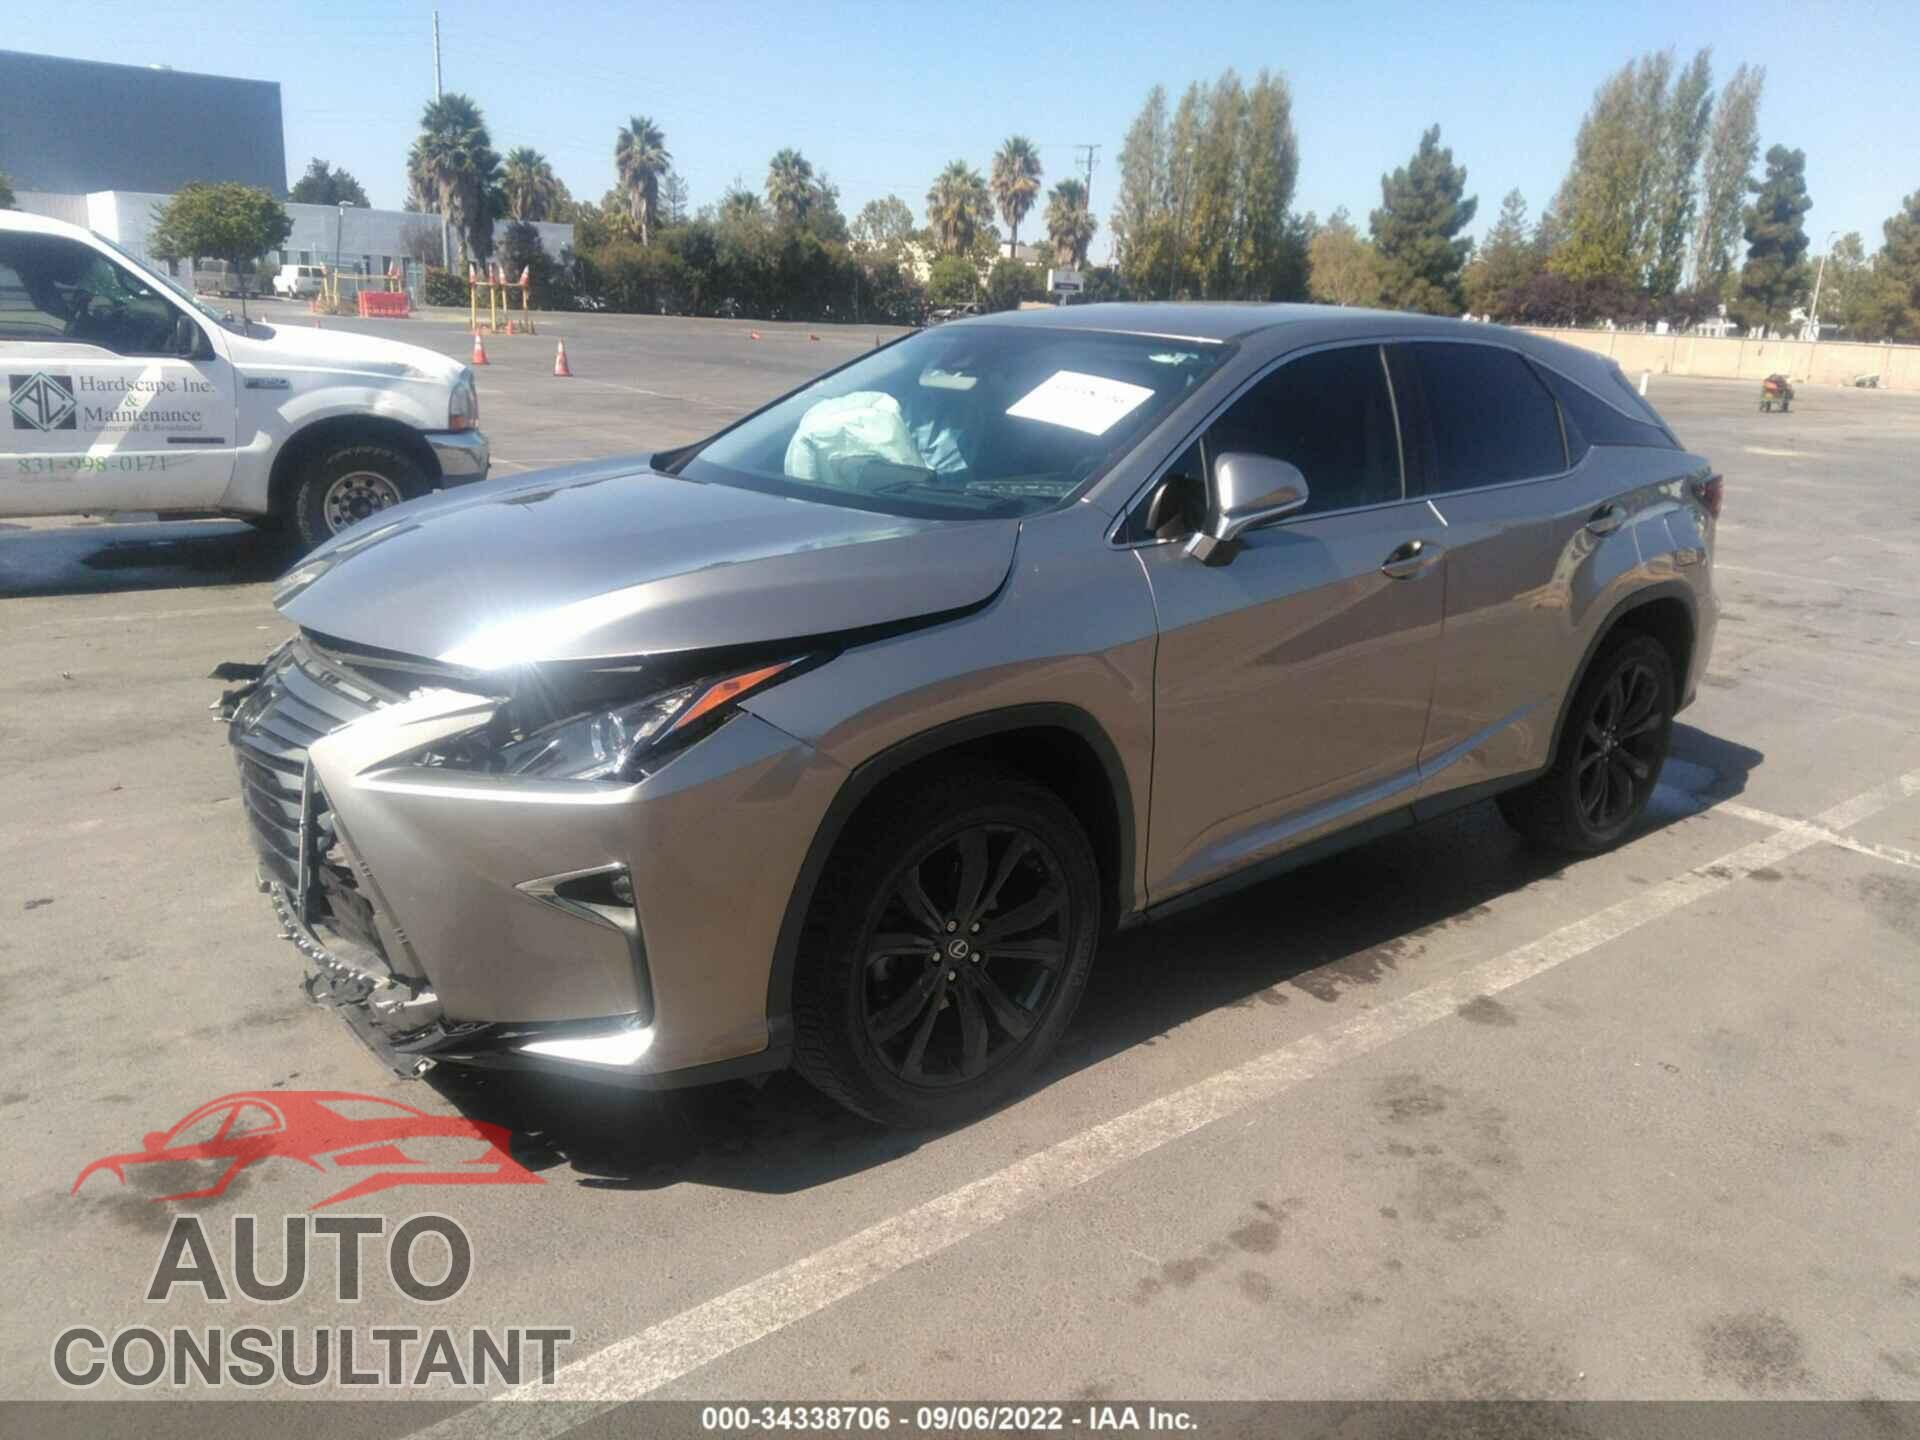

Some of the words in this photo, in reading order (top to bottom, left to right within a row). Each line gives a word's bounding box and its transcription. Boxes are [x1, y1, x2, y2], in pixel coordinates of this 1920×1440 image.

[80, 376, 177, 396] Hardscape
[125, 394, 138, 407] &
[84, 407, 201, 422] Maintenance
